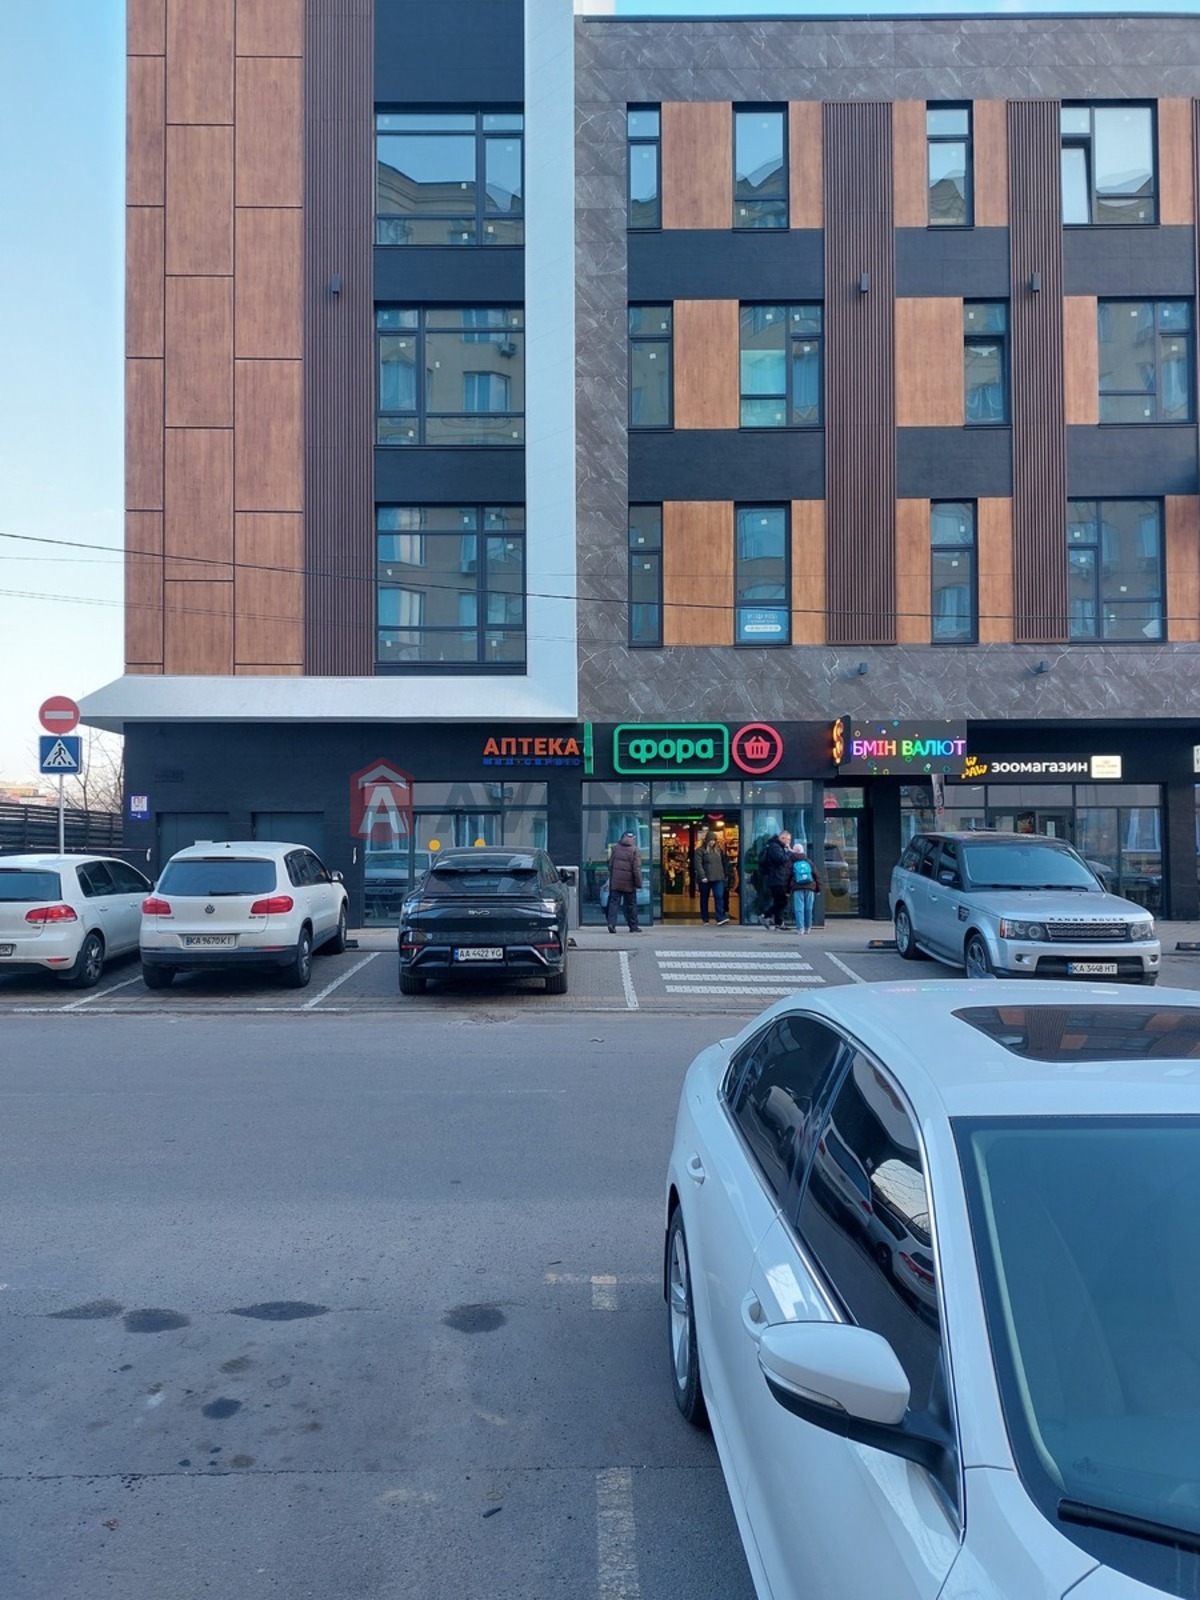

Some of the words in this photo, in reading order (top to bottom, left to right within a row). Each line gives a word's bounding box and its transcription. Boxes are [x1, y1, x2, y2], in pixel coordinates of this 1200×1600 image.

[483, 737, 580, 756] АПТЕКА
[629, 738, 714, 764] фора
[850, 739, 897, 756] БМІН
[901, 739, 966, 756] ВАЛЮТ
[991, 761, 1088, 773] зоомагазин
[460, 950, 470, 958] AA
[472, 949, 489, 958] 4422
[1073, 964, 1085, 973] KA
[1104, 964, 1116, 973] HT
